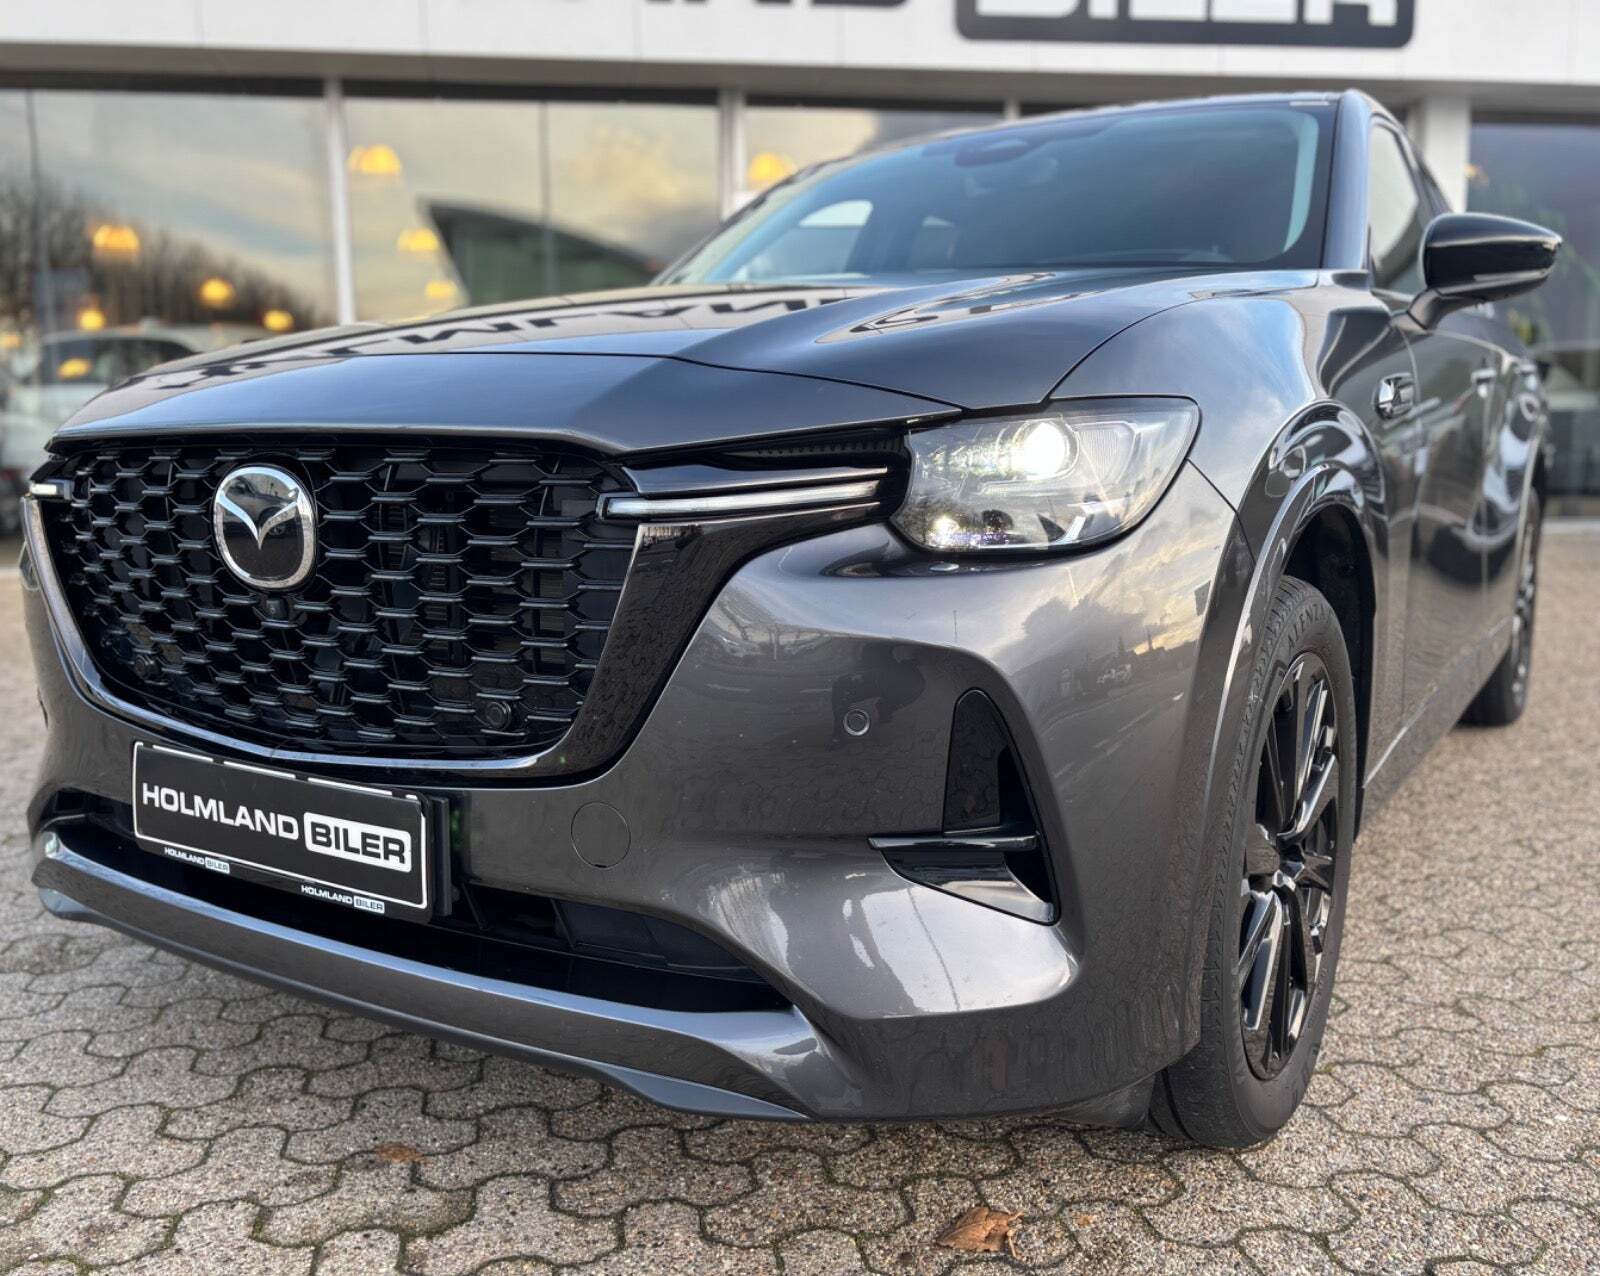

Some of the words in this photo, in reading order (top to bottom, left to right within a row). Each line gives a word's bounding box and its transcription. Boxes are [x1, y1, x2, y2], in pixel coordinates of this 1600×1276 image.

[142, 782, 299, 841] HOLMLAND
[311, 822, 406, 865] BILER
[164, 847, 206, 866] HOLMLAND
[206, 857, 230, 874] BILER
[301, 885, 353, 905] HOLMLAND
[355, 897, 384, 914] BILER
